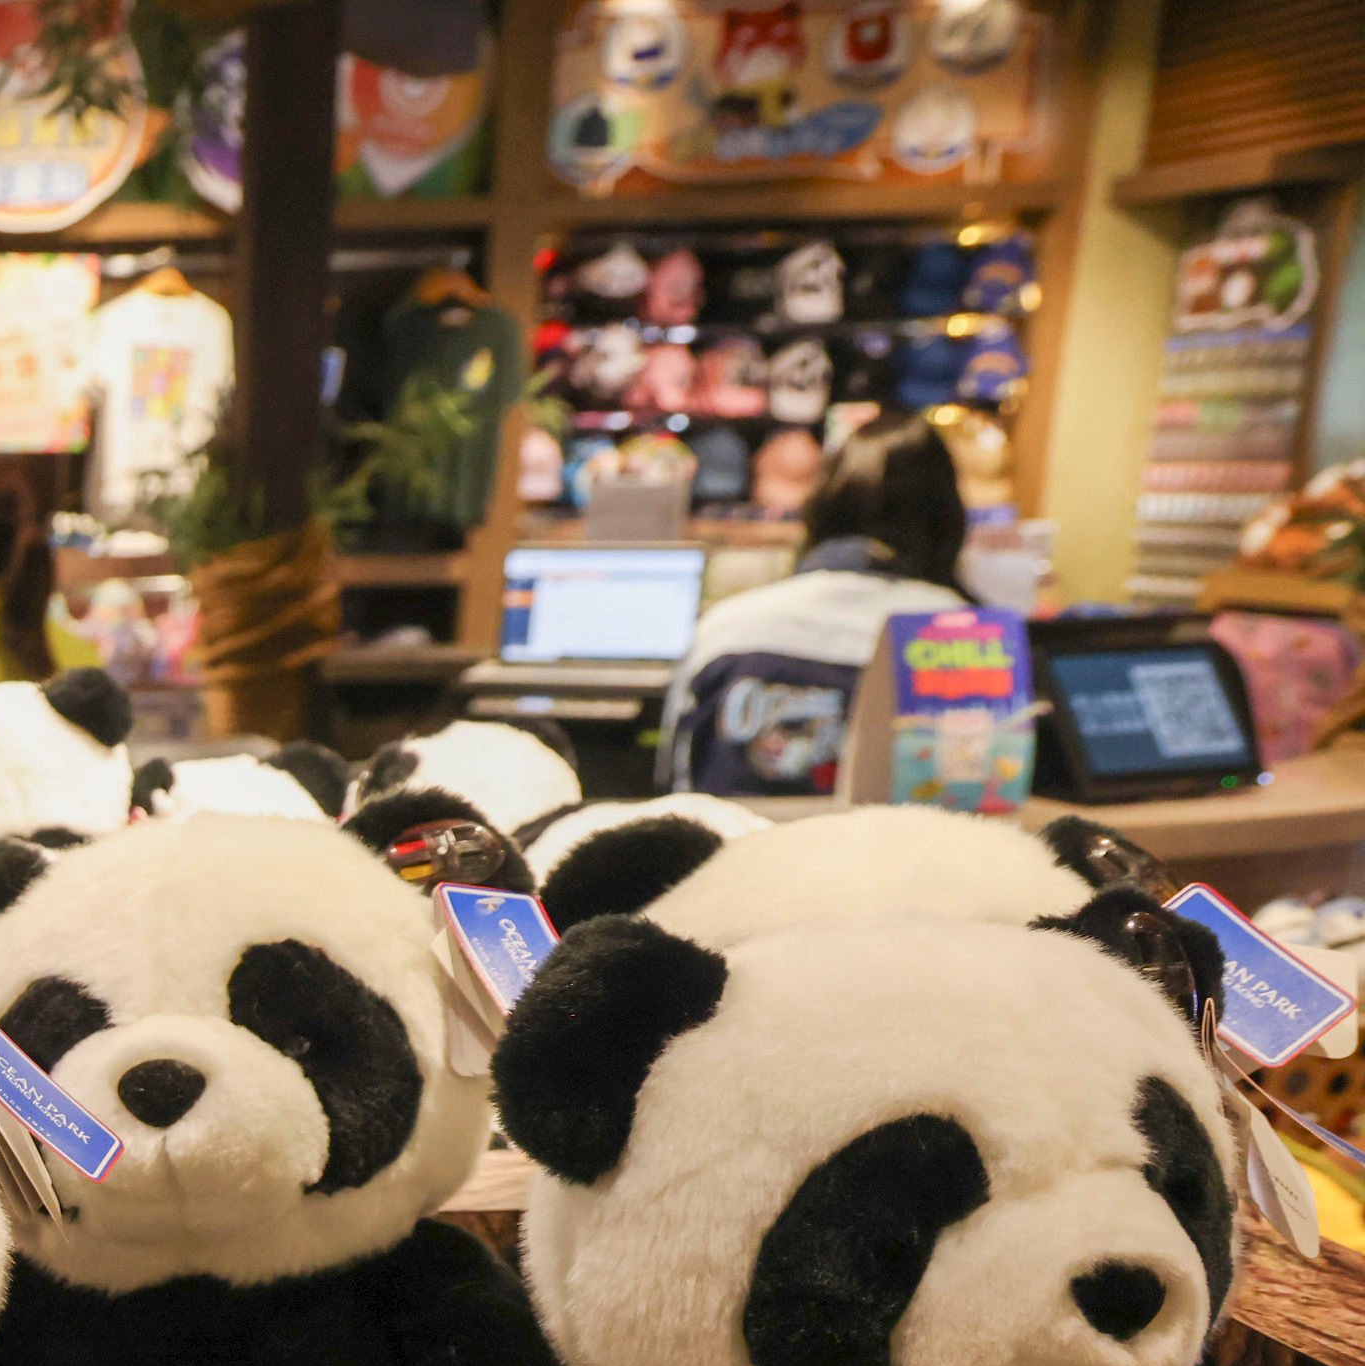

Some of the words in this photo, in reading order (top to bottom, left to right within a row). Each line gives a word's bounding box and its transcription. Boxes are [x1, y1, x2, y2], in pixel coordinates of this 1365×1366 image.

[1251, 979, 1303, 1020] PARK
[1, 1069, 32, 1101] HONG
[32, 1099, 64, 1129] KONG
[47, 1103, 92, 1146] PARK
